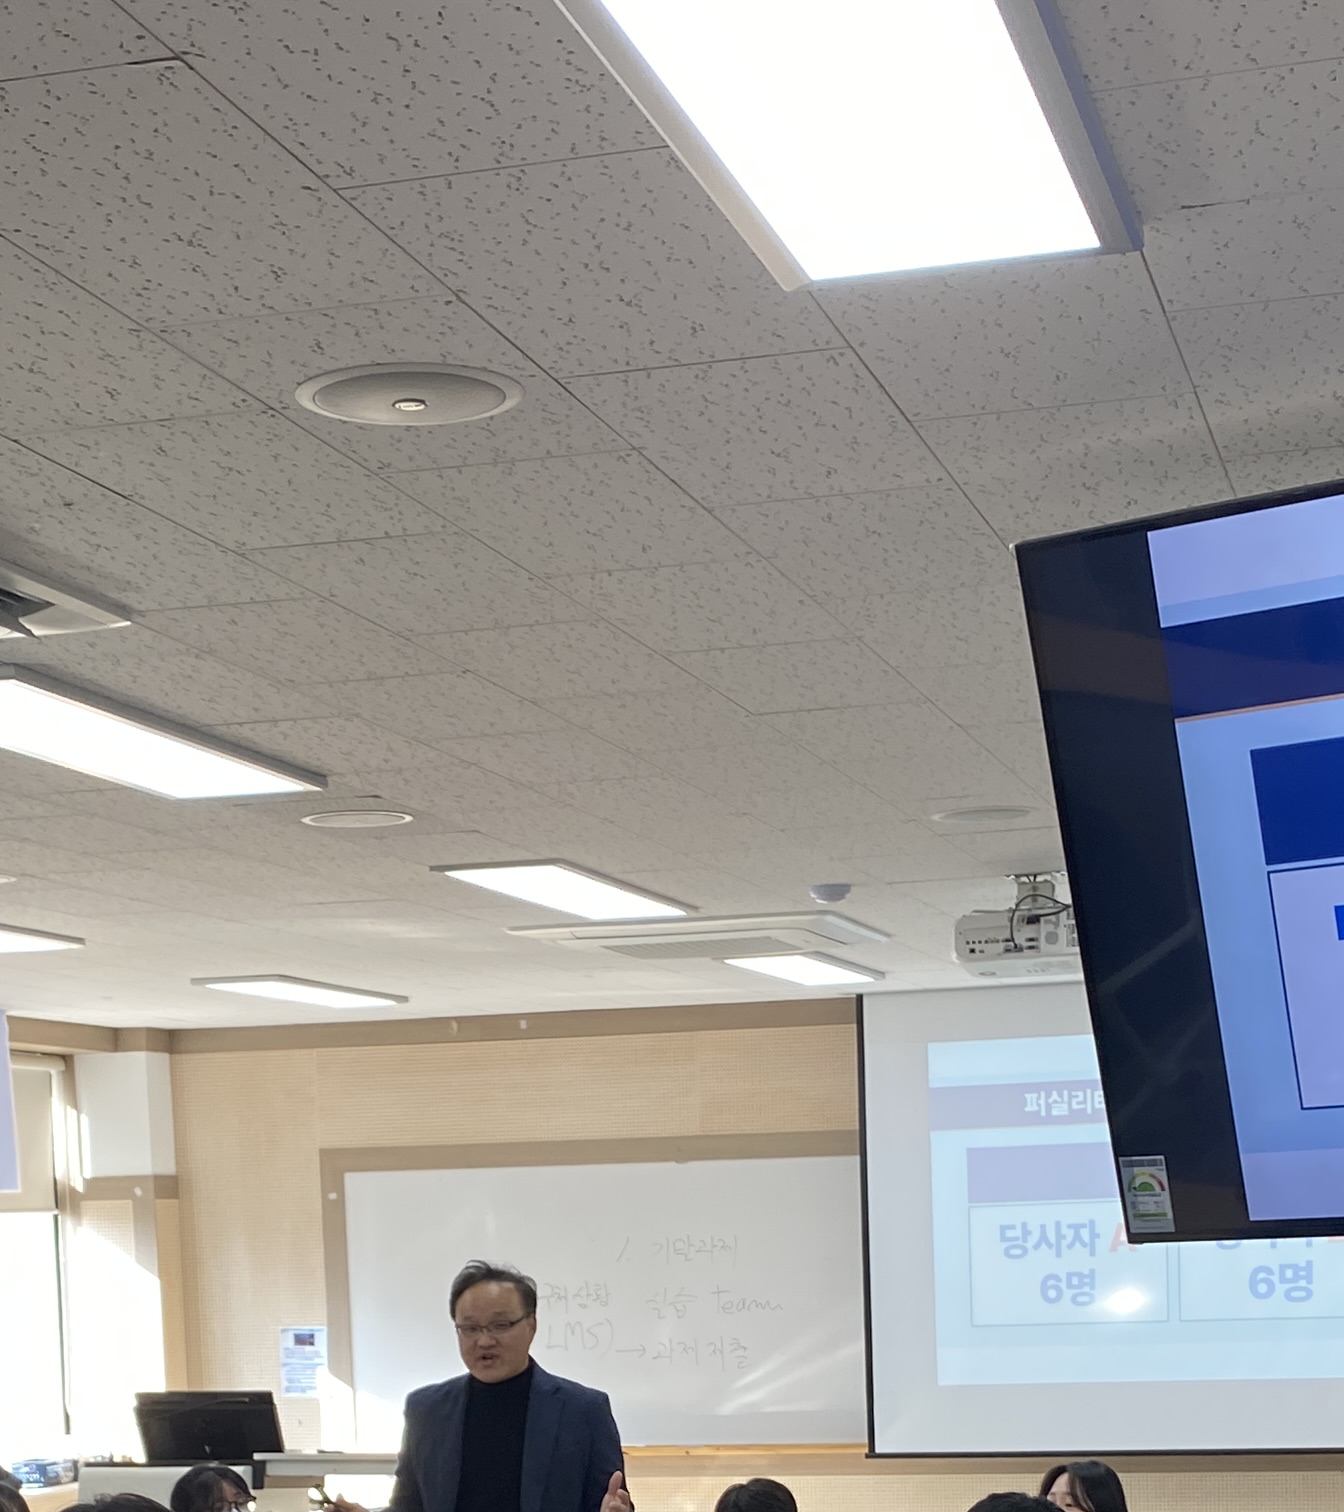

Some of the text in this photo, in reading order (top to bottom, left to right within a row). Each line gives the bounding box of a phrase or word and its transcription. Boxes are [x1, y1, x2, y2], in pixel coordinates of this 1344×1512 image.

[999, 1219, 1100, 1260] 당사자
[1040, 1268, 1096, 1307] 6명
[1248, 1260, 1315, 1303] 6명
